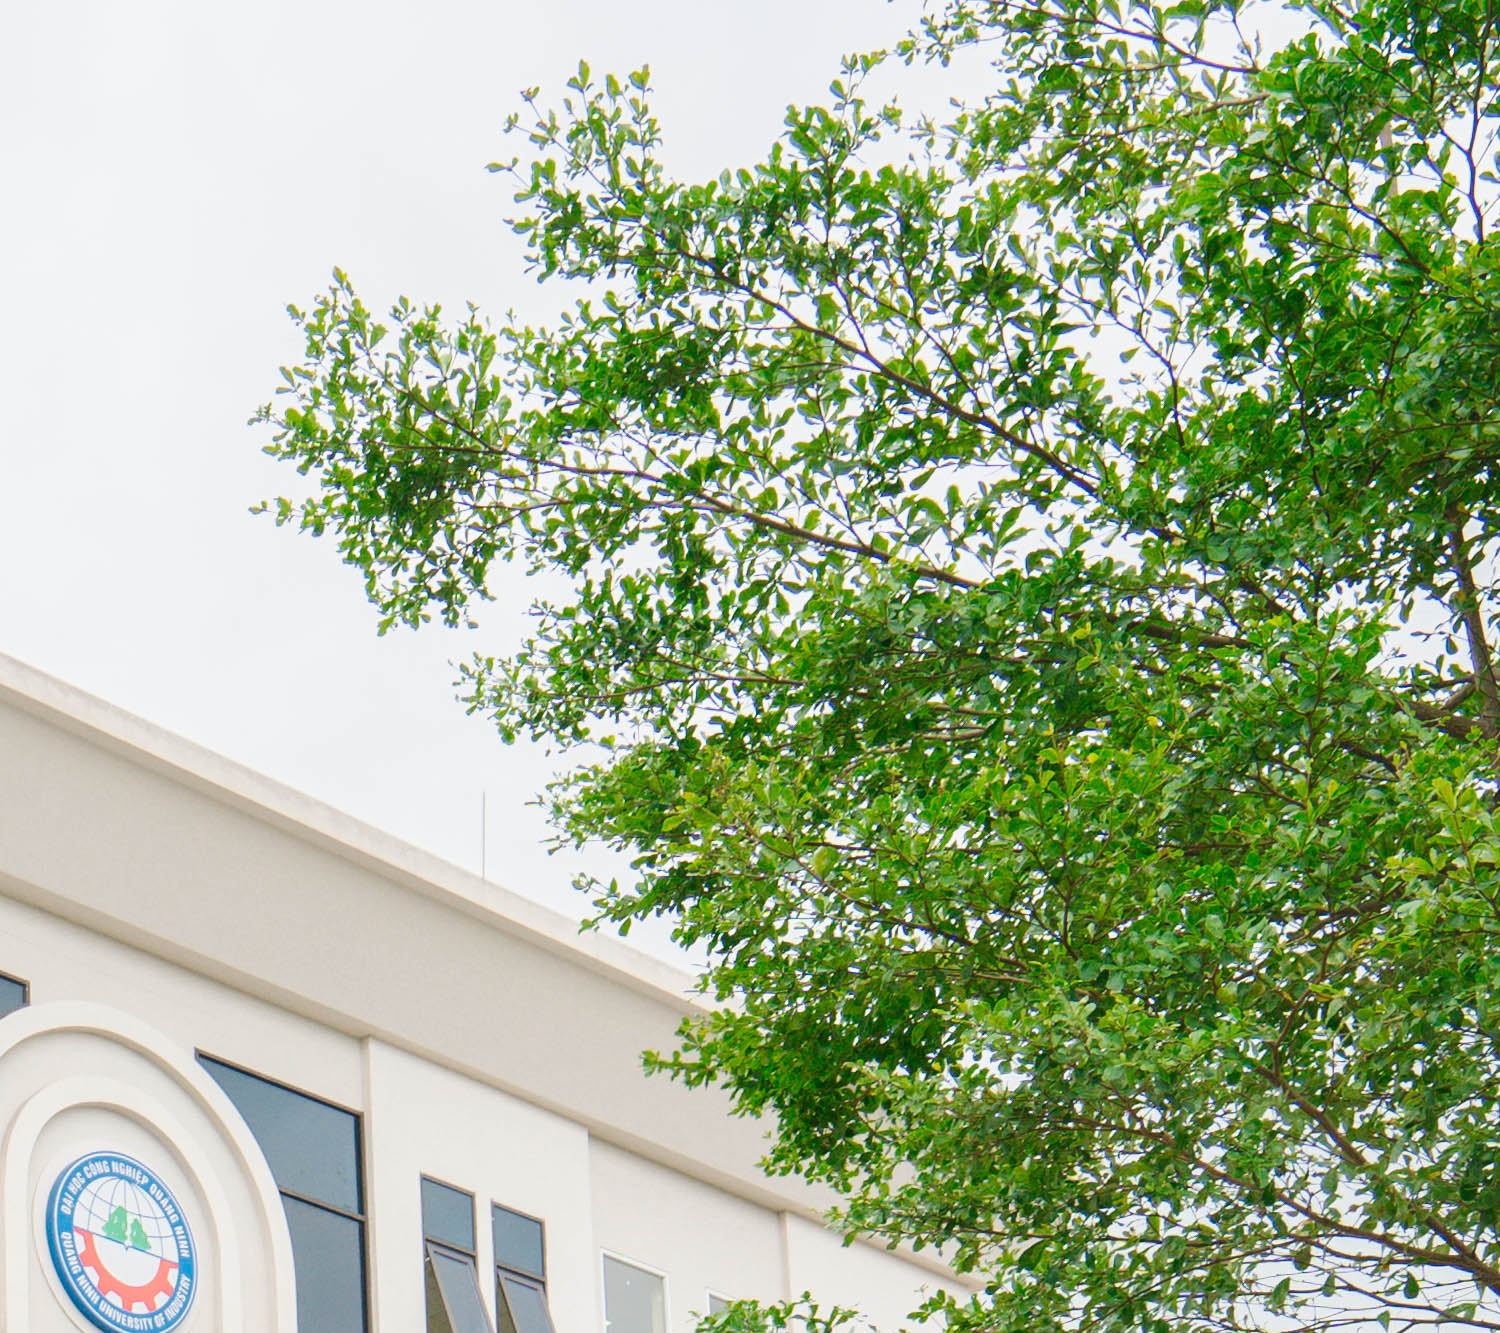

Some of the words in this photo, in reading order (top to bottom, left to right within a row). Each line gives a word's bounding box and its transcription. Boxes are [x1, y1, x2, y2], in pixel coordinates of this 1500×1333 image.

[61, 1232, 81, 1274] QUANG
[77, 1274, 101, 1303] NINH
[99, 1301, 154, 1331] UNIVERSITY
[154, 1312, 166, 1327] OF
[164, 1273, 191, 1321] INDUSTRY
